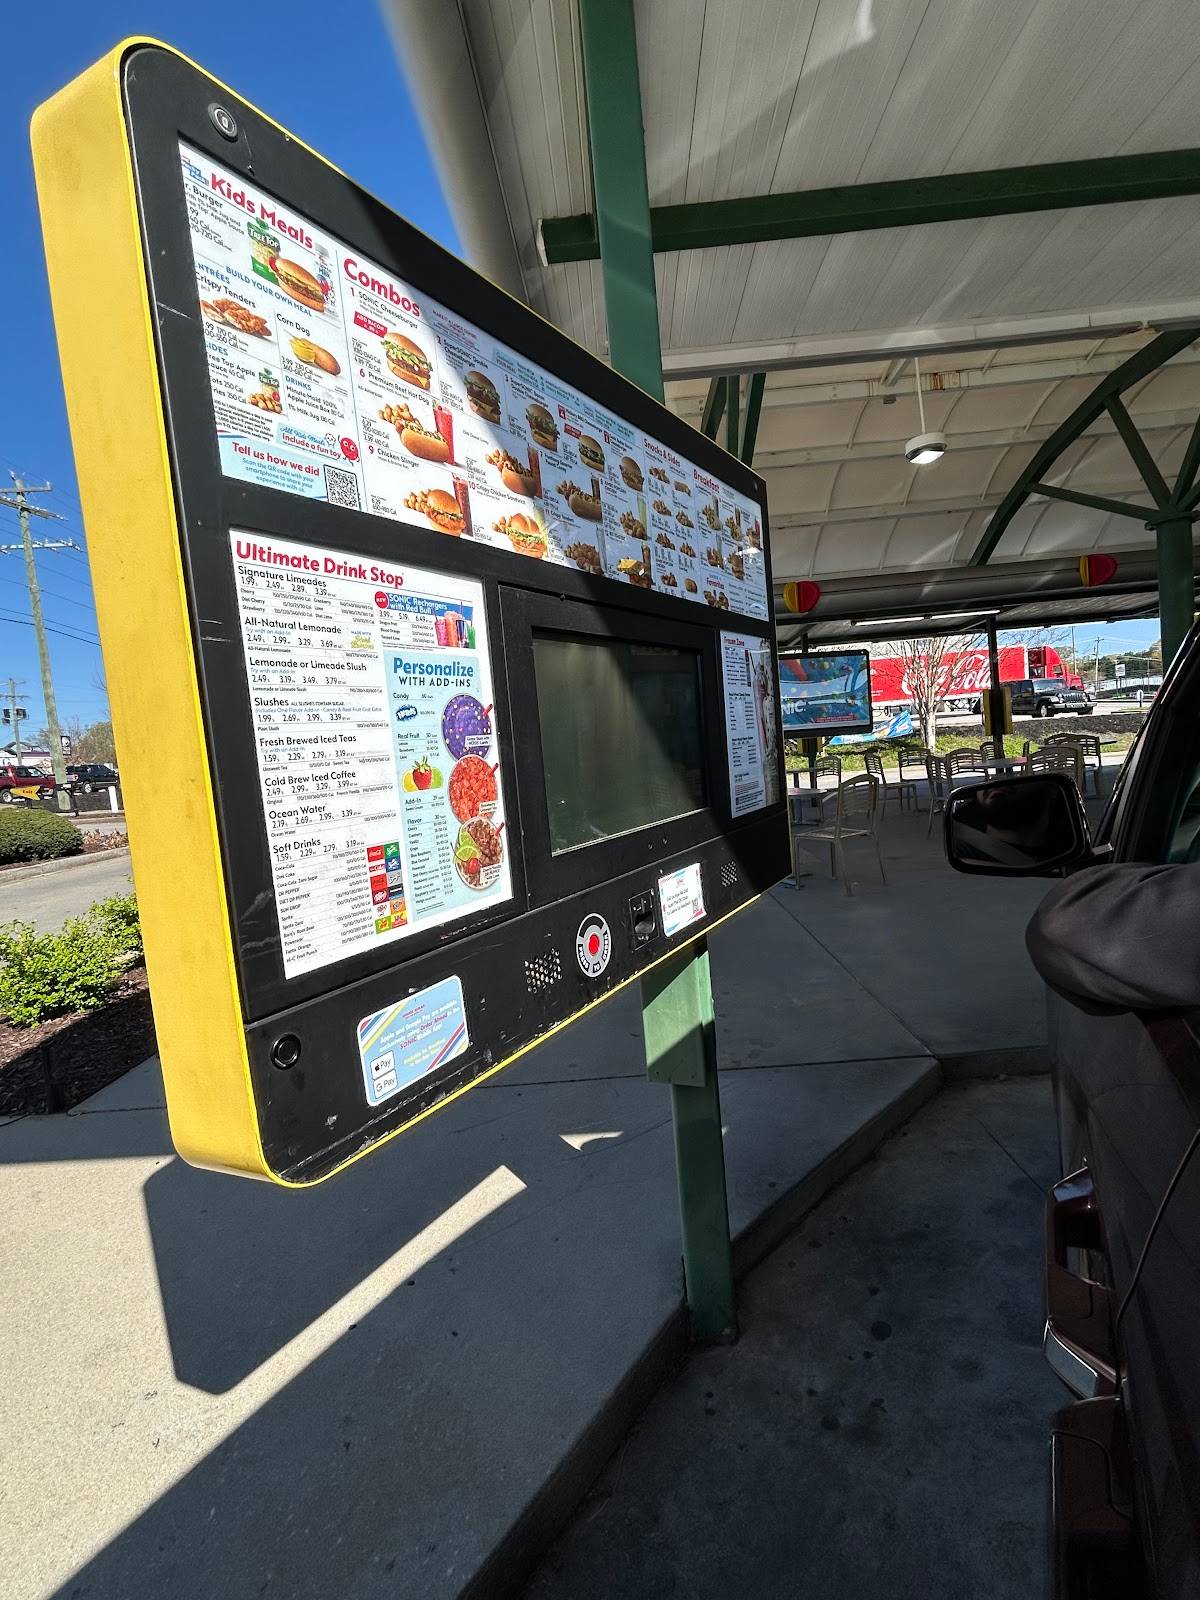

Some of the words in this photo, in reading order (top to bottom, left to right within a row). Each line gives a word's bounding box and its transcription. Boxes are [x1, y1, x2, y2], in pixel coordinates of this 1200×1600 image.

[193, 185, 223, 208] Burger
[211, 173, 255, 214] Kids
[261, 203, 313, 248] Meals
[210, 213, 226, 227] Apple
[228, 221, 245, 234] Sauce
[195, 272, 222, 292] Crispy
[223, 285, 256, 308] Tenders
[226, 265, 250, 284] BUILD
[252, 278, 273, 296] YOUR
[275, 292, 292, 306] OWN
[294, 302, 312, 317] MEAL
[344, 258, 420, 317] Combos
[351, 287, 355, 296] 1
[358, 291, 379, 307] SONIC
[380, 303, 418, 328] Cheeseburger
[276, 313, 294, 328] Corn
[295, 322, 310, 336] Dog
[368, 319, 385, 332] BACON
[222, 358, 234, 370] Top
[236, 364, 255, 378] Apple
[285, 375, 312, 391] DRINKS
[360, 368, 365, 378] 6
[368, 372, 394, 388] Premium
[395, 383, 407, 394] Beef
[408, 389, 418, 398] Hot
[420, 395, 430, 406] Dog
[286, 385, 305, 398] Minute
[306, 394, 319, 404] Maid
[288, 393, 305, 406] Apple
[282, 433, 309, 449] Include
[317, 444, 329, 454] fun
[330, 449, 341, 459] toy
[644, 438, 663, 458] Snacks
[663, 450, 667, 459] &
[667, 452, 681, 468] Sides
[232, 442, 250, 456] Tell
[254, 451, 265, 460] us
[267, 455, 288, 467] how
[290, 463, 303, 471] we
[305, 464, 320, 476] did
[368, 445, 374, 454] 9
[377, 448, 400, 461] Chicken
[401, 454, 420, 468] Stinger
[242, 458, 256, 467] Scan
[258, 462, 267, 470] the
[277, 467, 291, 476] code
[292, 471, 302, 480] with
[303, 475, 314, 484] your
[246, 466, 280, 480] smartphone
[287, 475, 301, 485] share
[302, 481, 313, 489] your
[256, 476, 286, 488] experience
[286, 483, 298, 491] with
[693, 468, 720, 494] Breakfast
[468, 481, 476, 491] 10
[476, 484, 489, 494] Crispy
[489, 487, 506, 499] Chicken
[507, 492, 526, 505] Sandwich
[236, 541, 320, 571] Ultimate
[324, 557, 367, 580] Drink
[370, 566, 404, 589] Stop
[238, 566, 284, 580] Signature
[286, 574, 326, 588] Limeades
[241, 577, 255, 586] 1.99
[266, 580, 280, 589] 2.49
[292, 584, 305, 593] 2.89
[315, 587, 327, 596] 3.39
[389, 594, 411, 604] SONIC
[413, 598, 447, 610] Rechargers
[406, 604, 419, 612] Red
[379, 610, 390, 618] 3.99
[245, 617, 296, 630] All-Natural
[298, 622, 341, 634] Lemonade
[247, 634, 262, 642] 2.49
[273, 636, 287, 644] 2.99
[320, 640, 333, 648] 3.69
[250, 657, 298, 668] Lemonade
[311, 660, 345, 670] Limeade
[346, 662, 367, 671] Slush
[393, 657, 473, 677] Personalize
[252, 674, 266, 682] 2.49
[280, 675, 292, 683] 3.19
[302, 676, 316, 684] 3.49
[399, 676, 425, 686] WITH
[429, 677, 471, 687] ADD-INS
[254, 697, 289, 706] Slushes
[258, 714, 272, 722] 1.99
[283, 714, 296, 722] 2.69
[260, 738, 284, 747] Fresh
[286, 736, 318, 745] Brewed
[320, 735, 337, 743] Iced
[339, 734, 356, 742] Teas
[264, 754, 276, 762] 1.59
[288, 752, 301, 760] 2.29
[312, 751, 325, 759] 2.79
[265, 777, 286, 787] Cold
[288, 775, 310, 784] Brew
[312, 773, 329, 782] Iced
[331, 770, 356, 780] Coffee
[266, 787, 281, 796] 2.49
[292, 785, 305, 793] 2.99
[338, 780, 350, 788] 3.99
[269, 808, 299, 820] Ocean
[300, 805, 326, 814] Water
[273, 820, 285, 828] 2.19
[296, 816, 309, 825] 2.69
[341, 809, 352, 817] 3.39
[273, 842, 291, 854] Soft
[294, 838, 321, 850] Drinks
[277, 852, 289, 862] 1.59
[300, 849, 313, 858] 2.29
[324, 844, 336, 852] 2.79
[346, 840, 356, 848] 3.19
[578, 946, 589, 968] PRESS
[400, 1036, 417, 1050] SONIC
[380, 1058, 391, 1069] Pay
[376, 1082, 382, 1092] G
[383, 1078, 395, 1087] Pay
